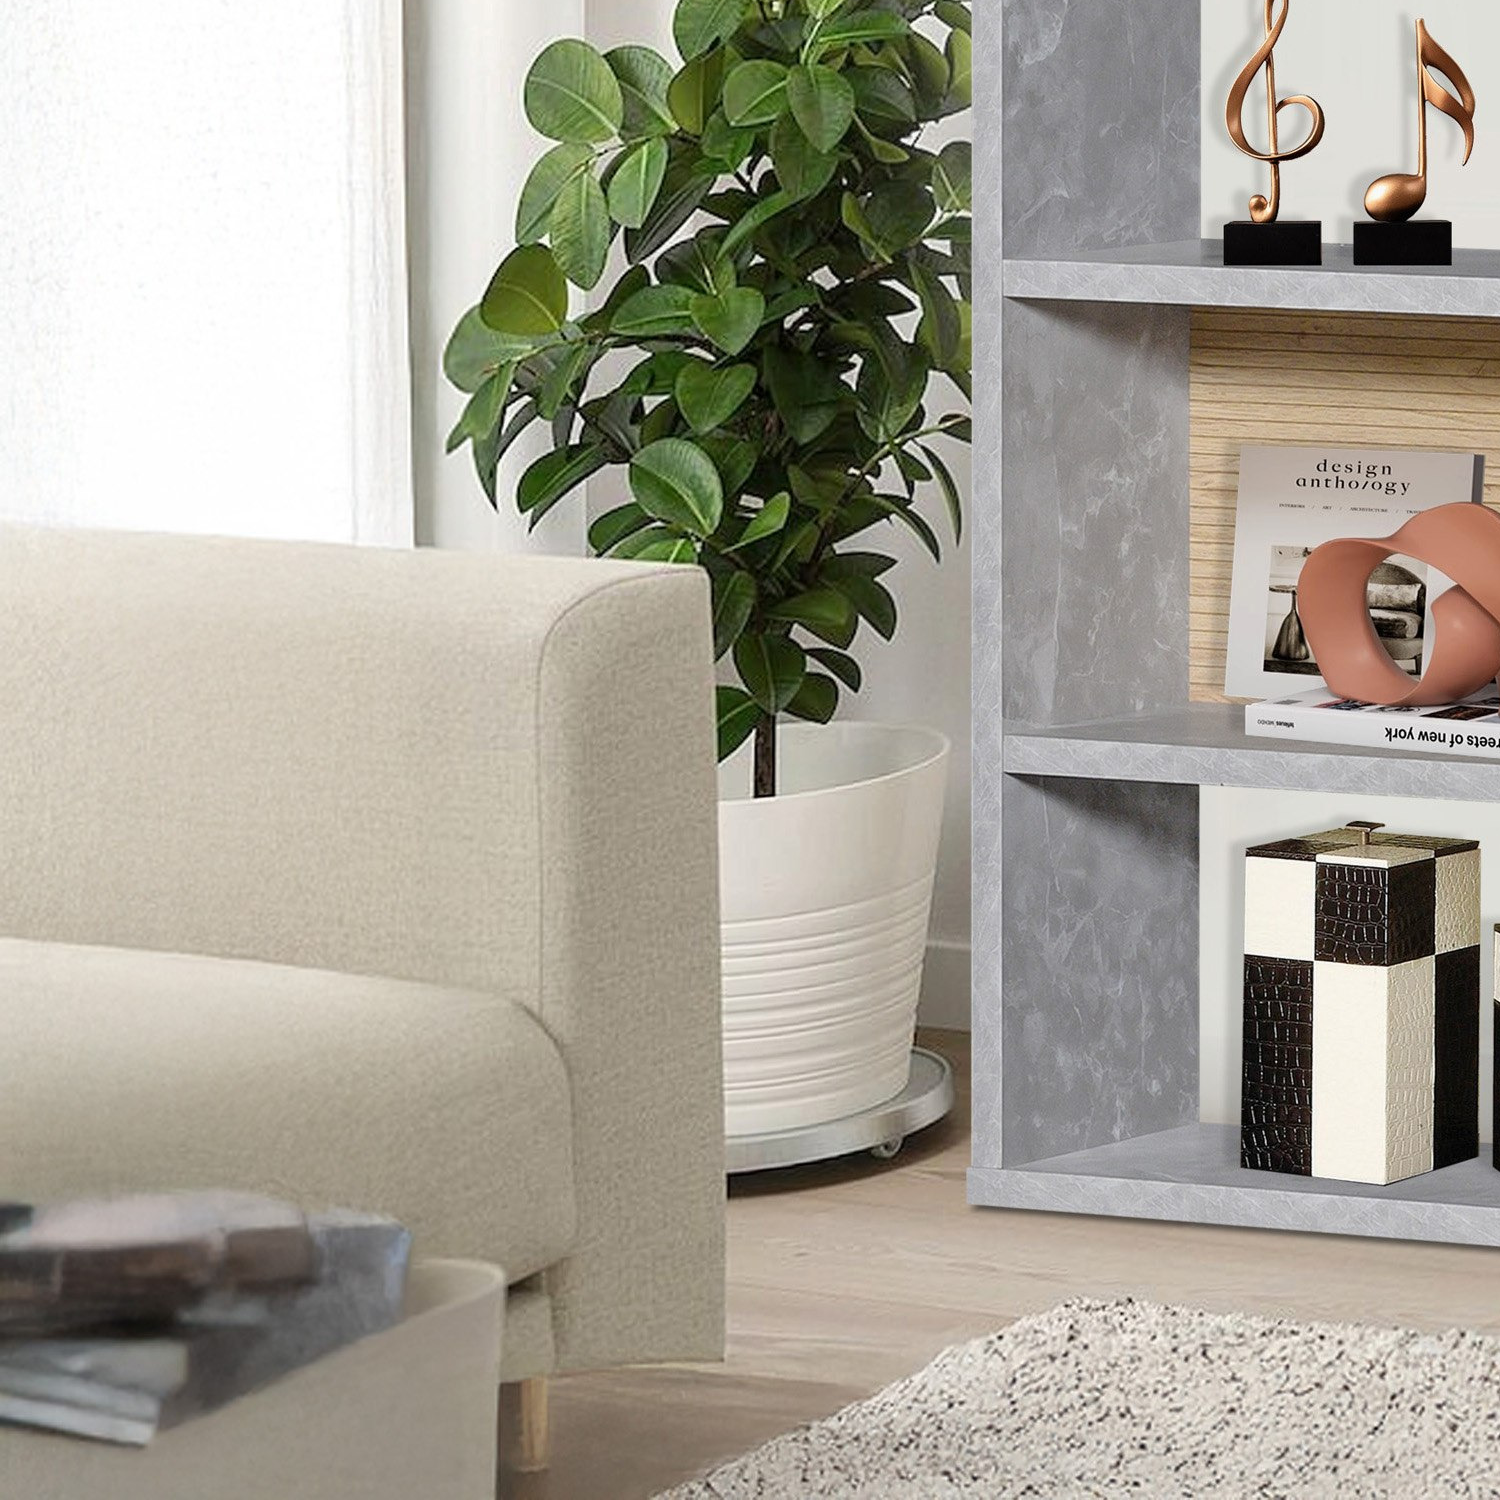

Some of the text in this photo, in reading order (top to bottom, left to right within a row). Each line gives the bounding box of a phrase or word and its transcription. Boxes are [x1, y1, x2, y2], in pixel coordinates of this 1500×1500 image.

[1315, 458, 1393, 478] design
[1295, 474, 1412, 496] anthology
[1384, 726, 1415, 742] york
[1417, 731, 1447, 743] new
[1449, 733, 1464, 748] of
